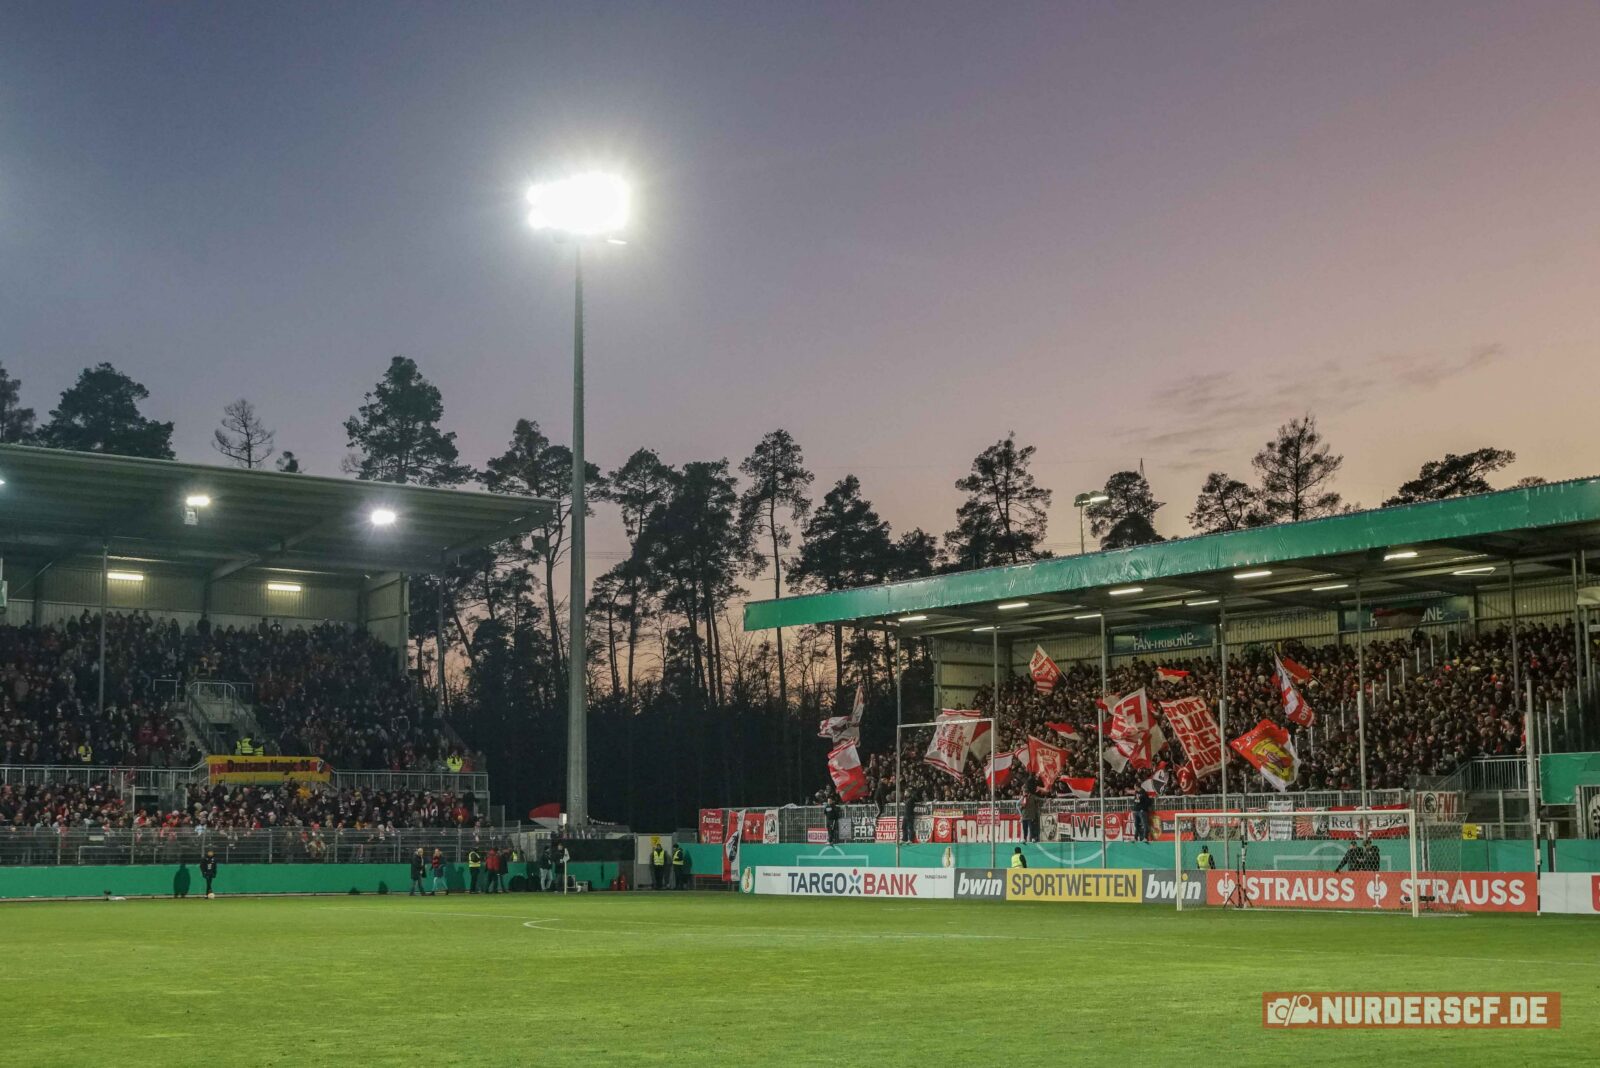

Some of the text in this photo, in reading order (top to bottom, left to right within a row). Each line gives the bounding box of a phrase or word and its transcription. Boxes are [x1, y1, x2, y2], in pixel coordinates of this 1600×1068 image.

[1331, 816, 1353, 829] Red
[957, 871, 1003, 896] bwin
[1012, 873, 1136, 897] SPORTWETTEN
[1145, 873, 1201, 900] bwin
[1247, 877, 1355, 902] STRAUSS
[1400, 878, 1525, 905] STRAUSS
